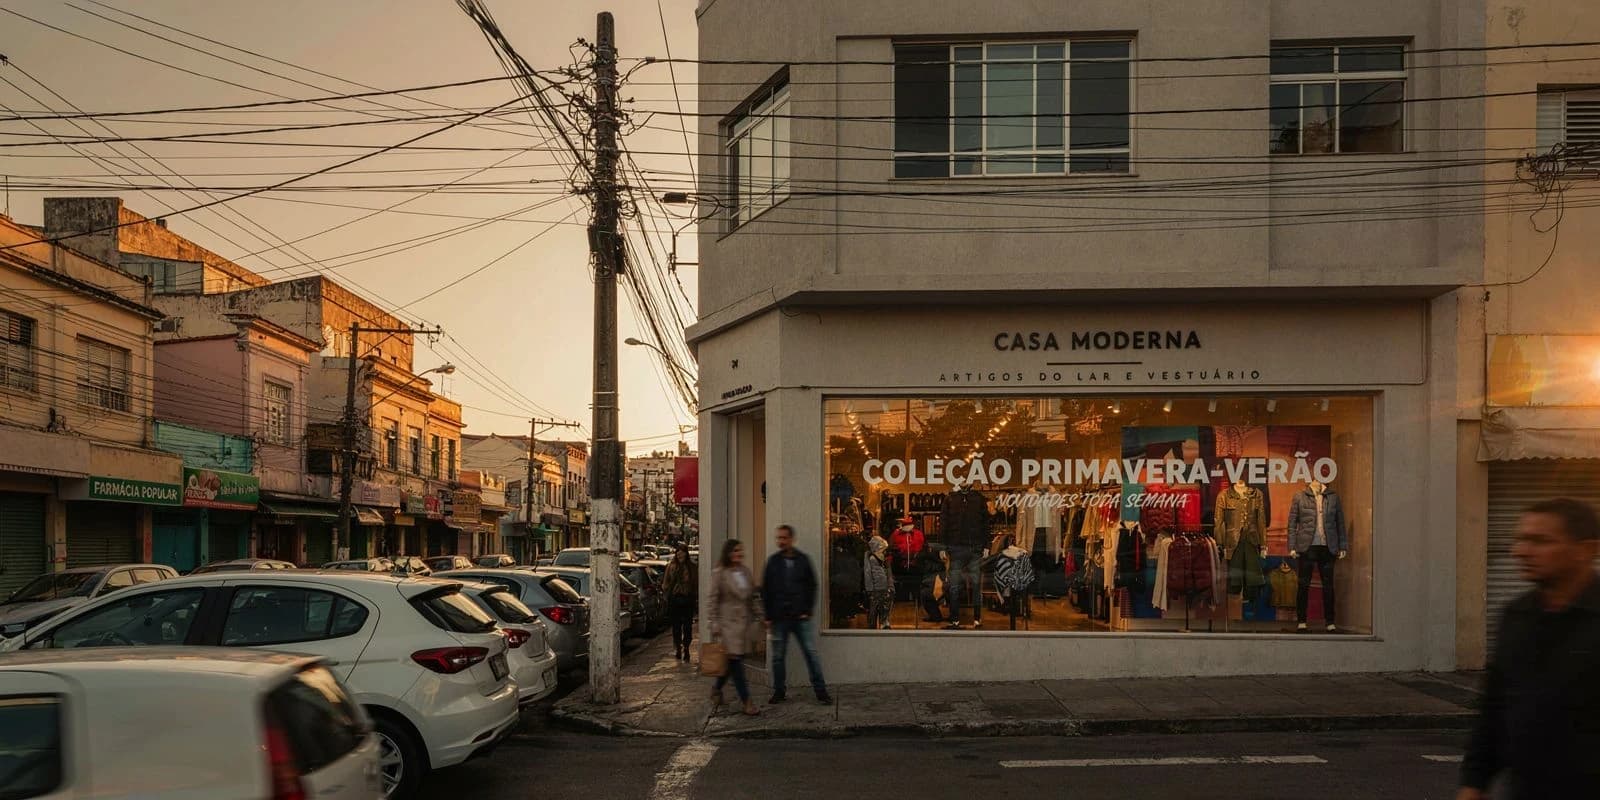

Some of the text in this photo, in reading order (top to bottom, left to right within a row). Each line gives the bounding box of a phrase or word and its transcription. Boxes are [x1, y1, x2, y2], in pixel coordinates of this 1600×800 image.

[994, 330, 1202, 351] CASA MODERNA
[939, 368, 1261, 382] ARTIGOS DO LAR E VESTUÁRIO
[862, 451, 1338, 492] COLEÇÃO PRIMAVERA-VERÃO
[94, 481, 140, 498] FARMÁCIA
[141, 486, 178, 501] POPULAR
[995, 492, 1188, 508] NOVIDADES TODA SEMANA
